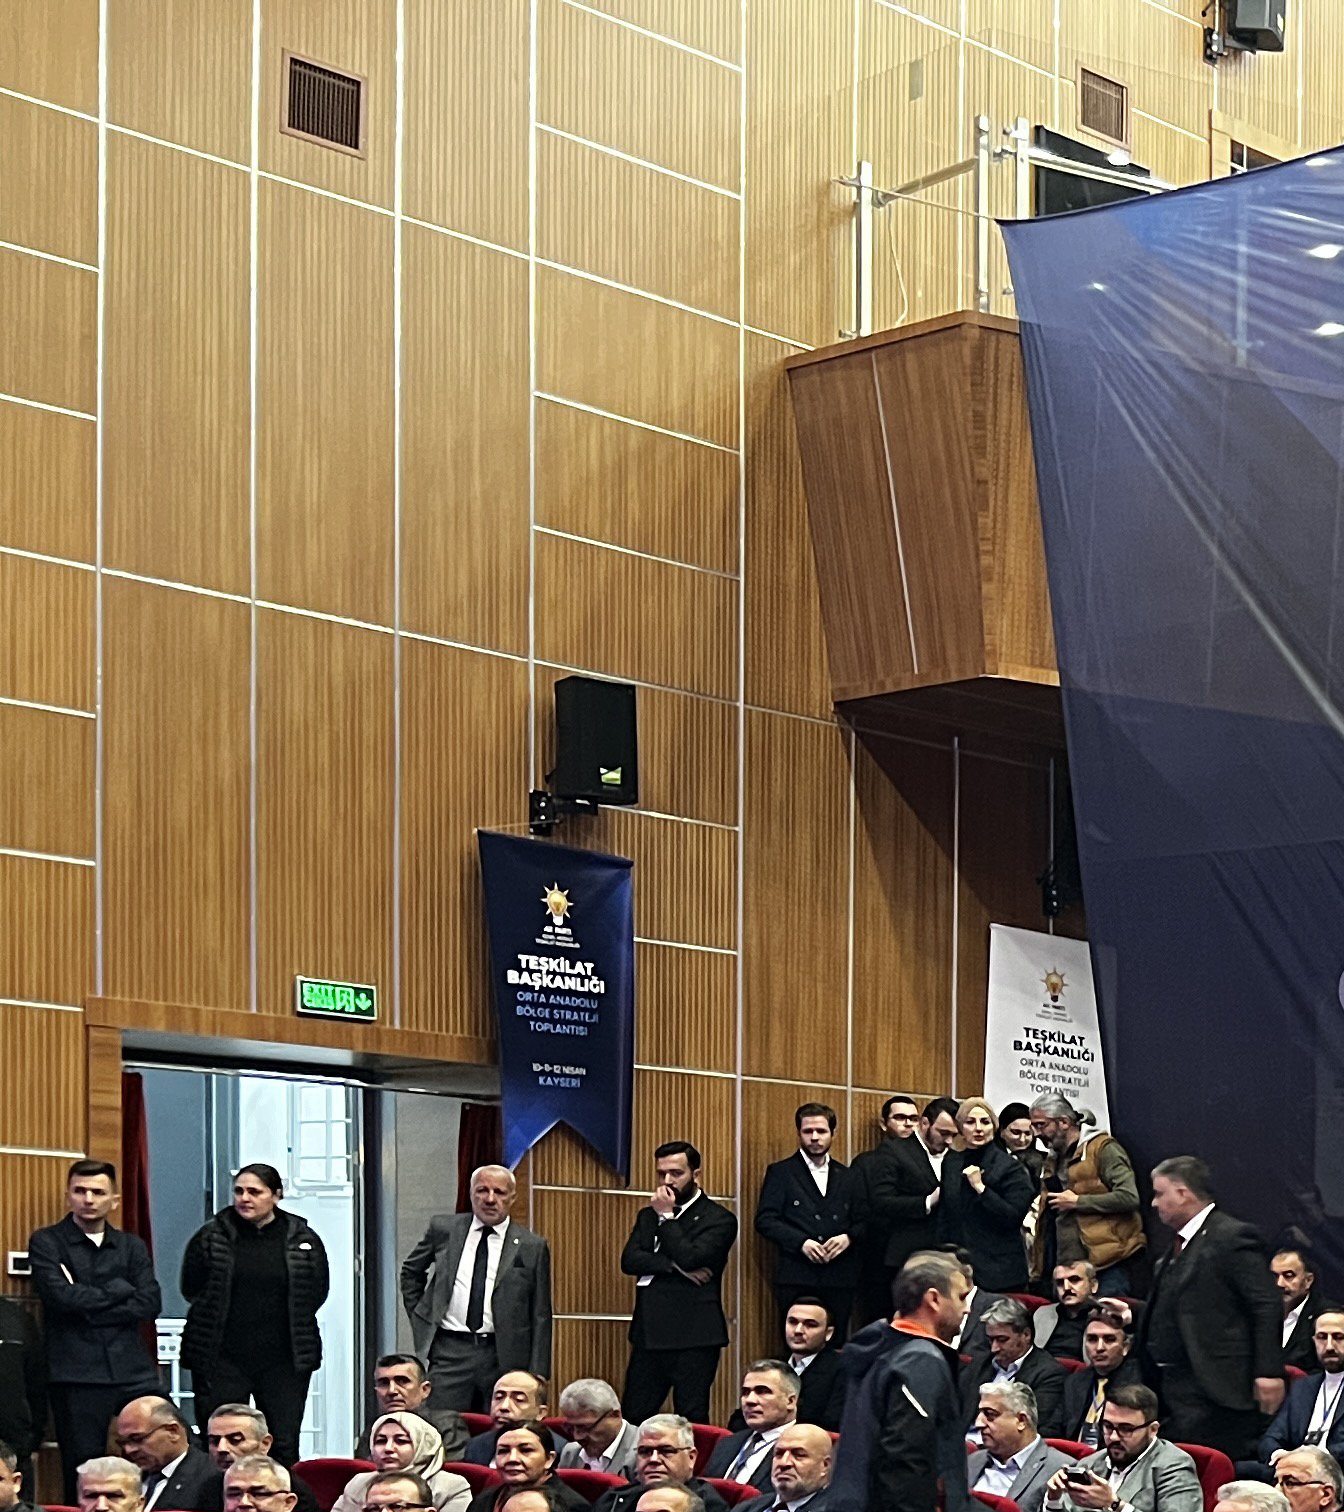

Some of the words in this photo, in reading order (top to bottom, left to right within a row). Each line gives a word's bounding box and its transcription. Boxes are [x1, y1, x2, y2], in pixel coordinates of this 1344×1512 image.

[507, 969, 605, 994] BAŞKANLIĞI
[516, 991, 546, 1004] ORTA
[1013, 1039, 1095, 1062] BAŞKANLIĞI
